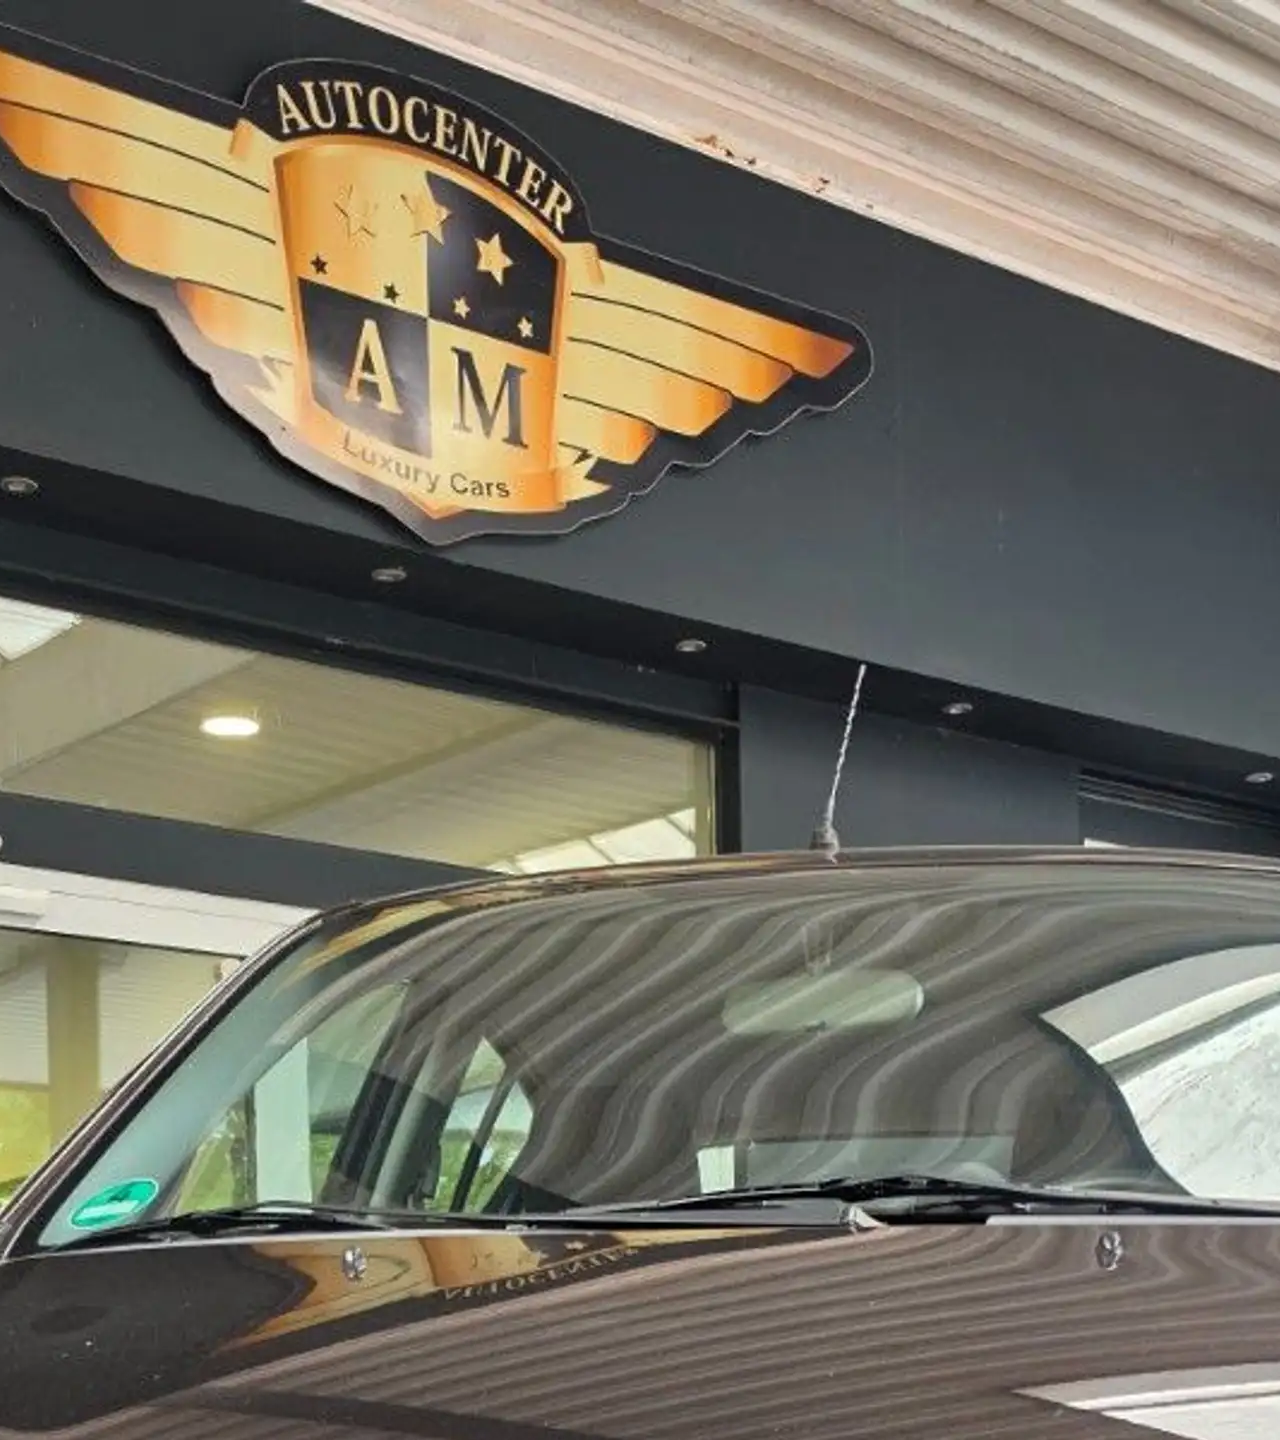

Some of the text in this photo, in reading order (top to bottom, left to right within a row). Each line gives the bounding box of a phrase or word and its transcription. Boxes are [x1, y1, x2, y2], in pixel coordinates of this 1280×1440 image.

[276, 80, 573, 235] AUTOCENTER
[344, 318, 529, 450] A M
[342, 428, 511, 499] Luxury Cars
